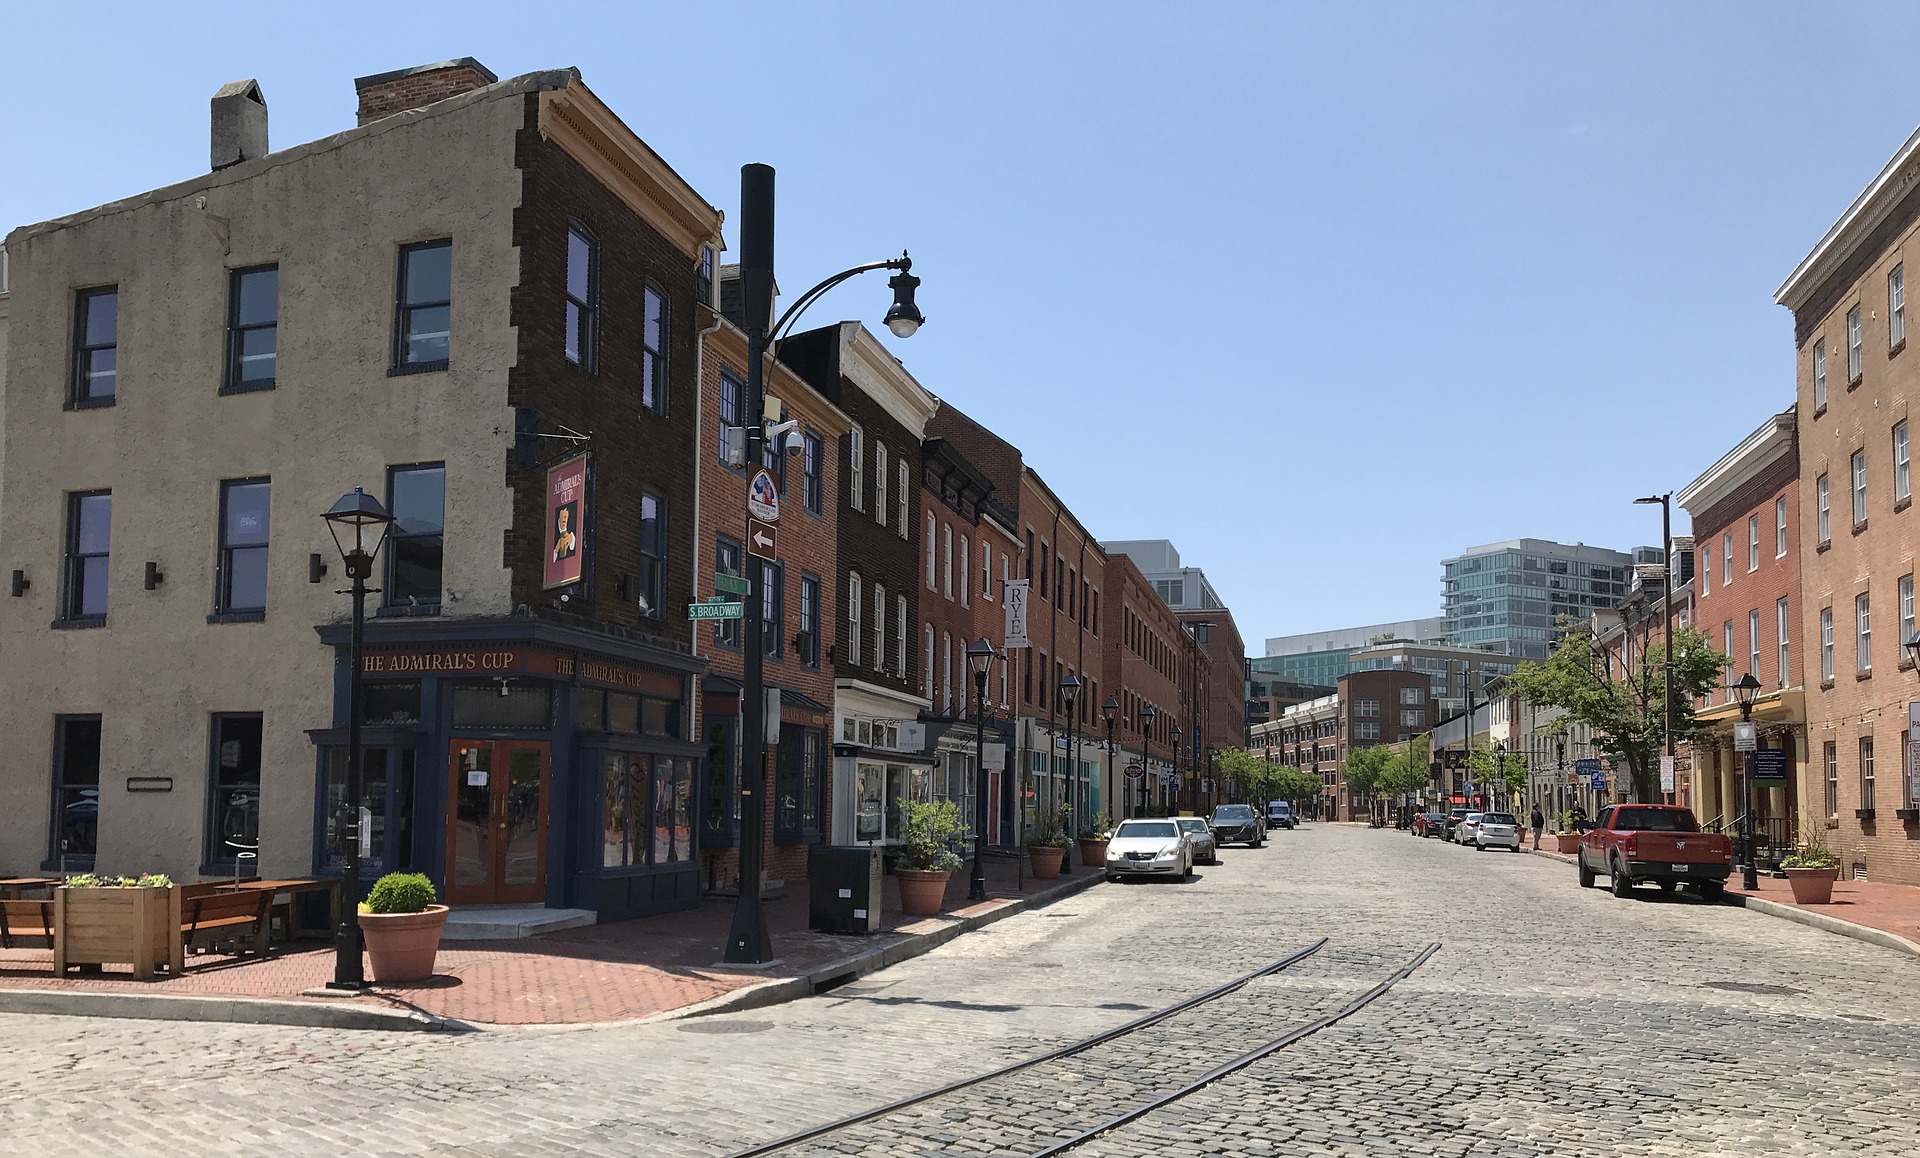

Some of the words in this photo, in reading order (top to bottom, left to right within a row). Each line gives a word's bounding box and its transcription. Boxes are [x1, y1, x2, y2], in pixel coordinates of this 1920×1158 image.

[560, 489, 573, 504] CUP
[1010, 588, 1022, 634] RYE
[362, 656, 385, 672] HE
[389, 653, 476, 671] ADMIRAL'S
[482, 652, 514, 668] CUP
[556, 658, 574, 675] THE
[580, 662, 624, 684] ADMIRAL'S
[626, 671, 642, 687] CUP
